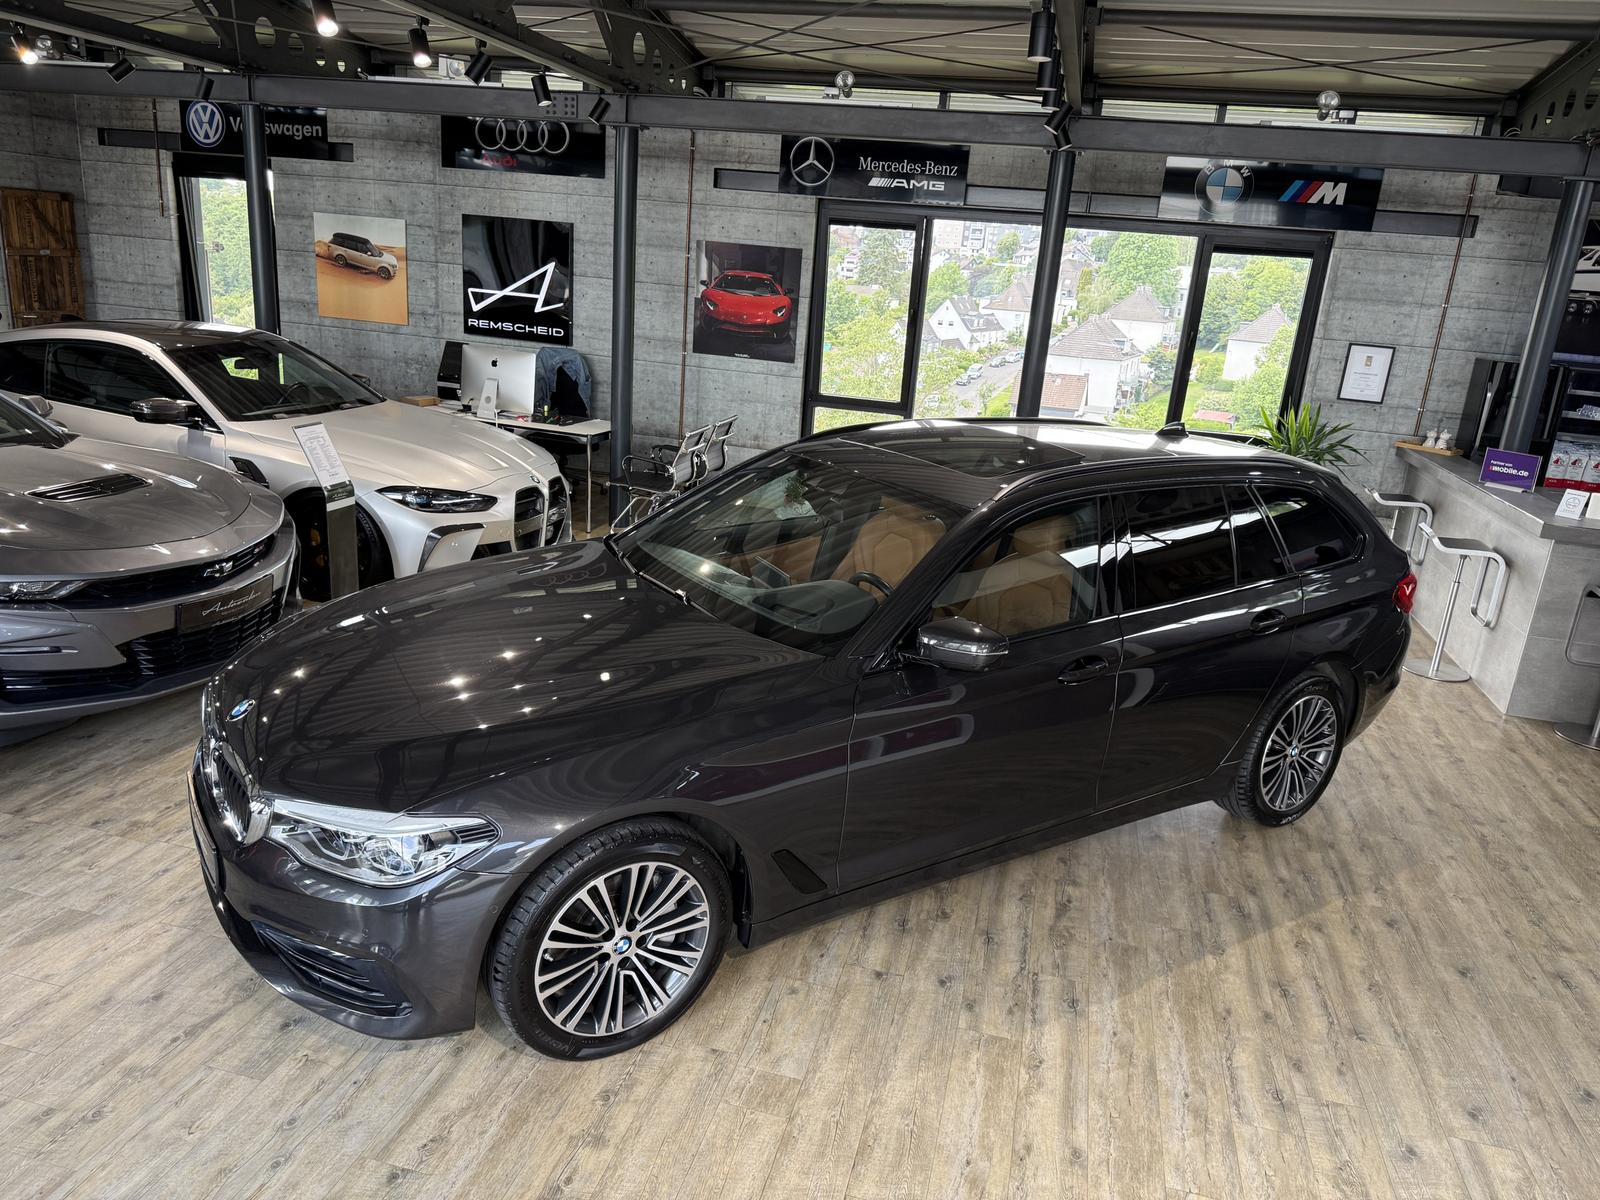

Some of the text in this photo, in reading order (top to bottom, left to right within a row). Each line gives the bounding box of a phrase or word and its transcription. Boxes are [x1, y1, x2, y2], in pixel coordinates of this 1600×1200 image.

[229, 116, 322, 140] Vswagen
[480, 153, 518, 167] Audi
[858, 156, 958, 177] Mercedes-Benz
[1204, 159, 1251, 178] BMW
[890, 178, 945, 191] AMG
[1306, 181, 1348, 205] M
[467, 318, 564, 337] REMSCHEID
